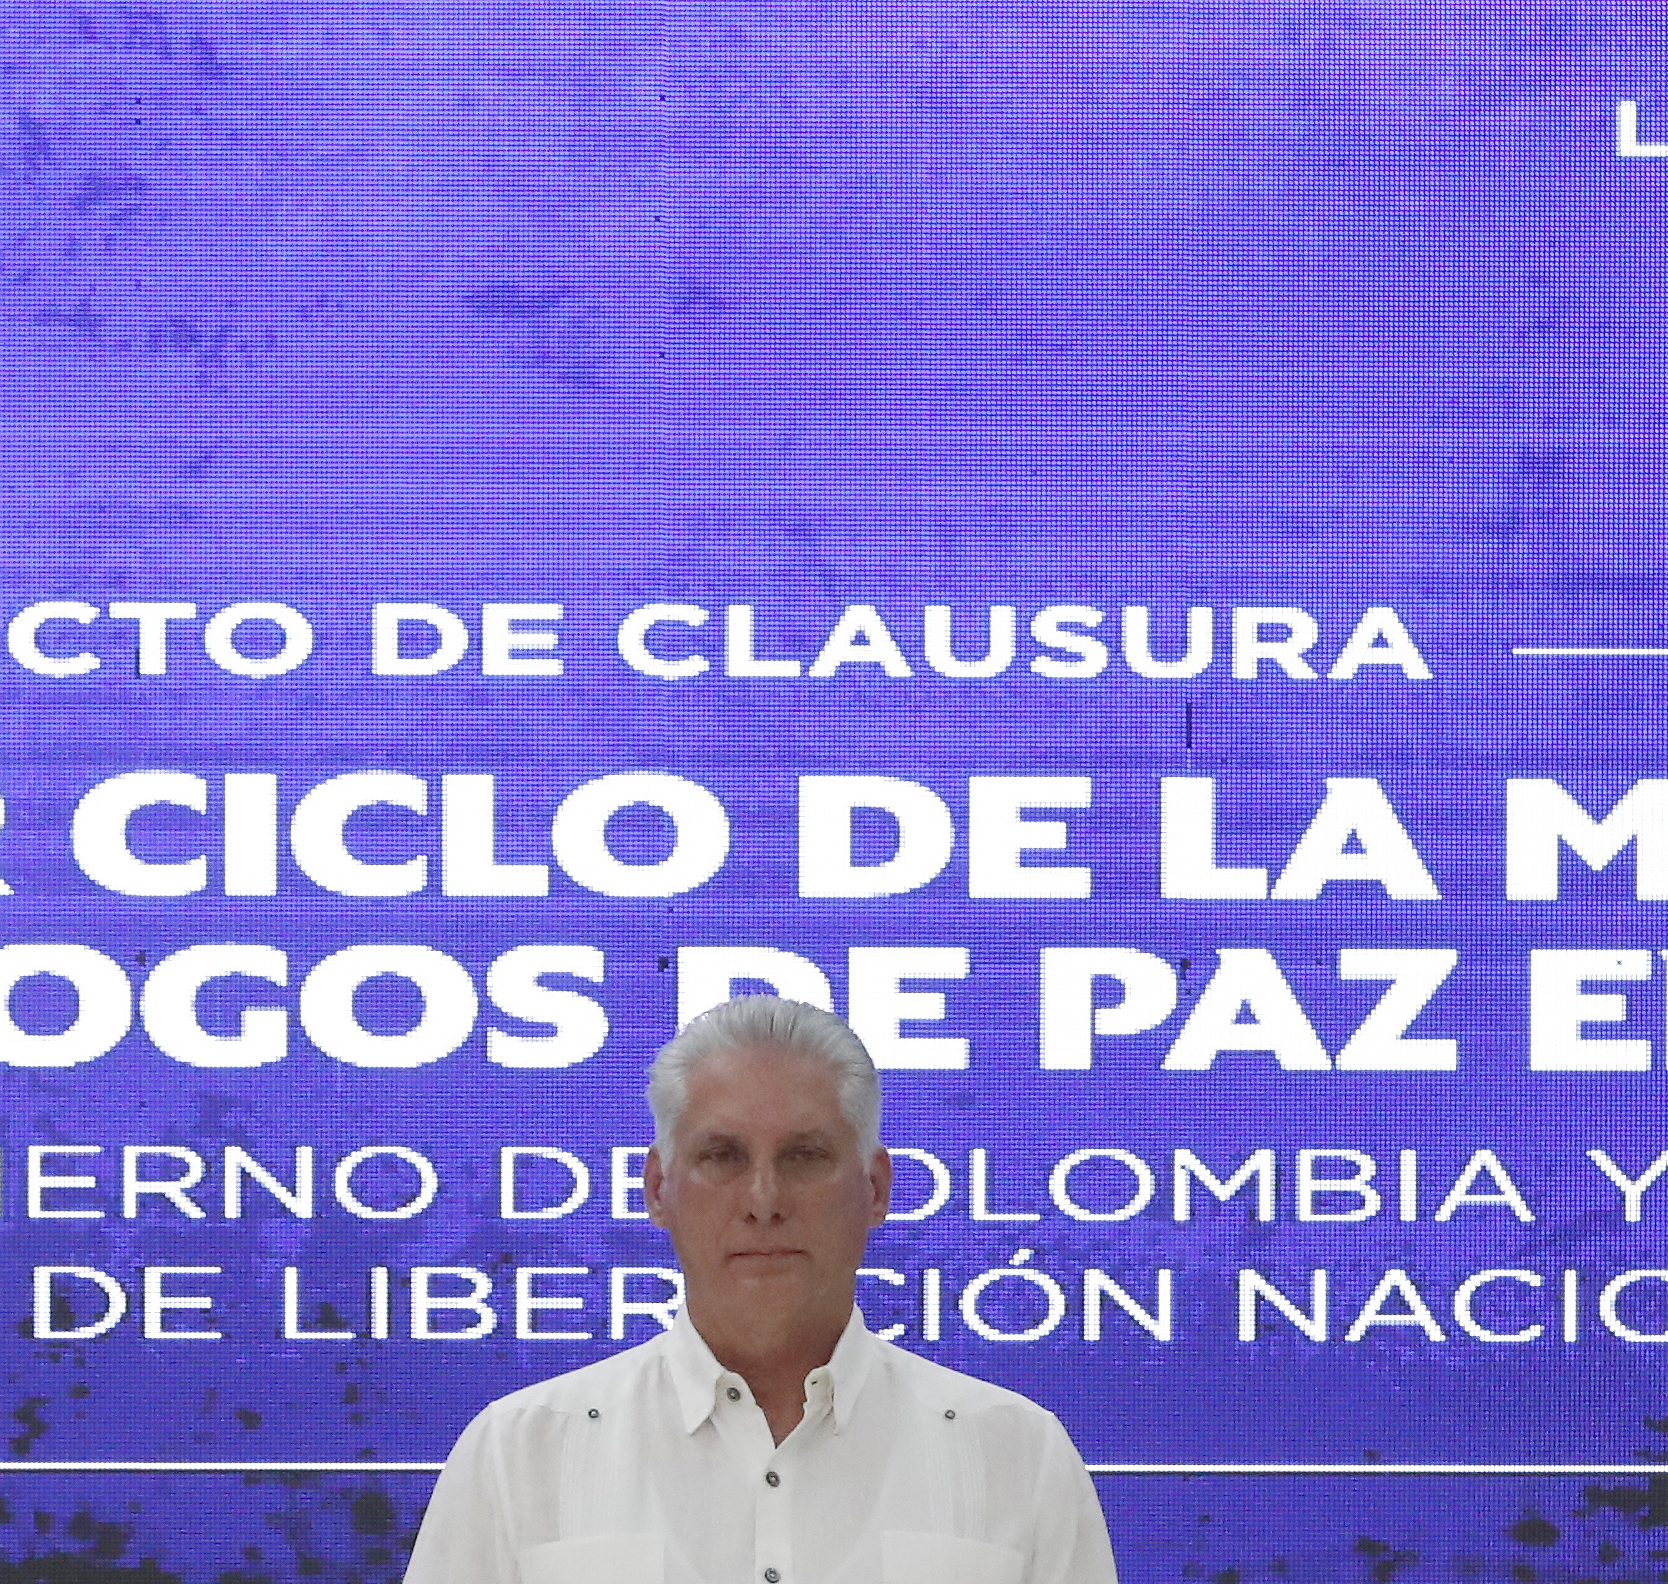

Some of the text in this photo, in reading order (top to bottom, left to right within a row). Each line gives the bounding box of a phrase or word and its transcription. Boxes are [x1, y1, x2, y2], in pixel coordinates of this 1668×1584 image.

[370, 600, 564, 678] DE
[615, 600, 1433, 681] CLAUSURA
[69, 768, 731, 899] CICLO
[796, 772, 1094, 900] DE
[1158, 774, 1441, 902] LA
[1038, 945, 1460, 1072] PAZ
[885, 1146, 1534, 1223] OLOMBIA
[33, 1263, 222, 1340] DE
